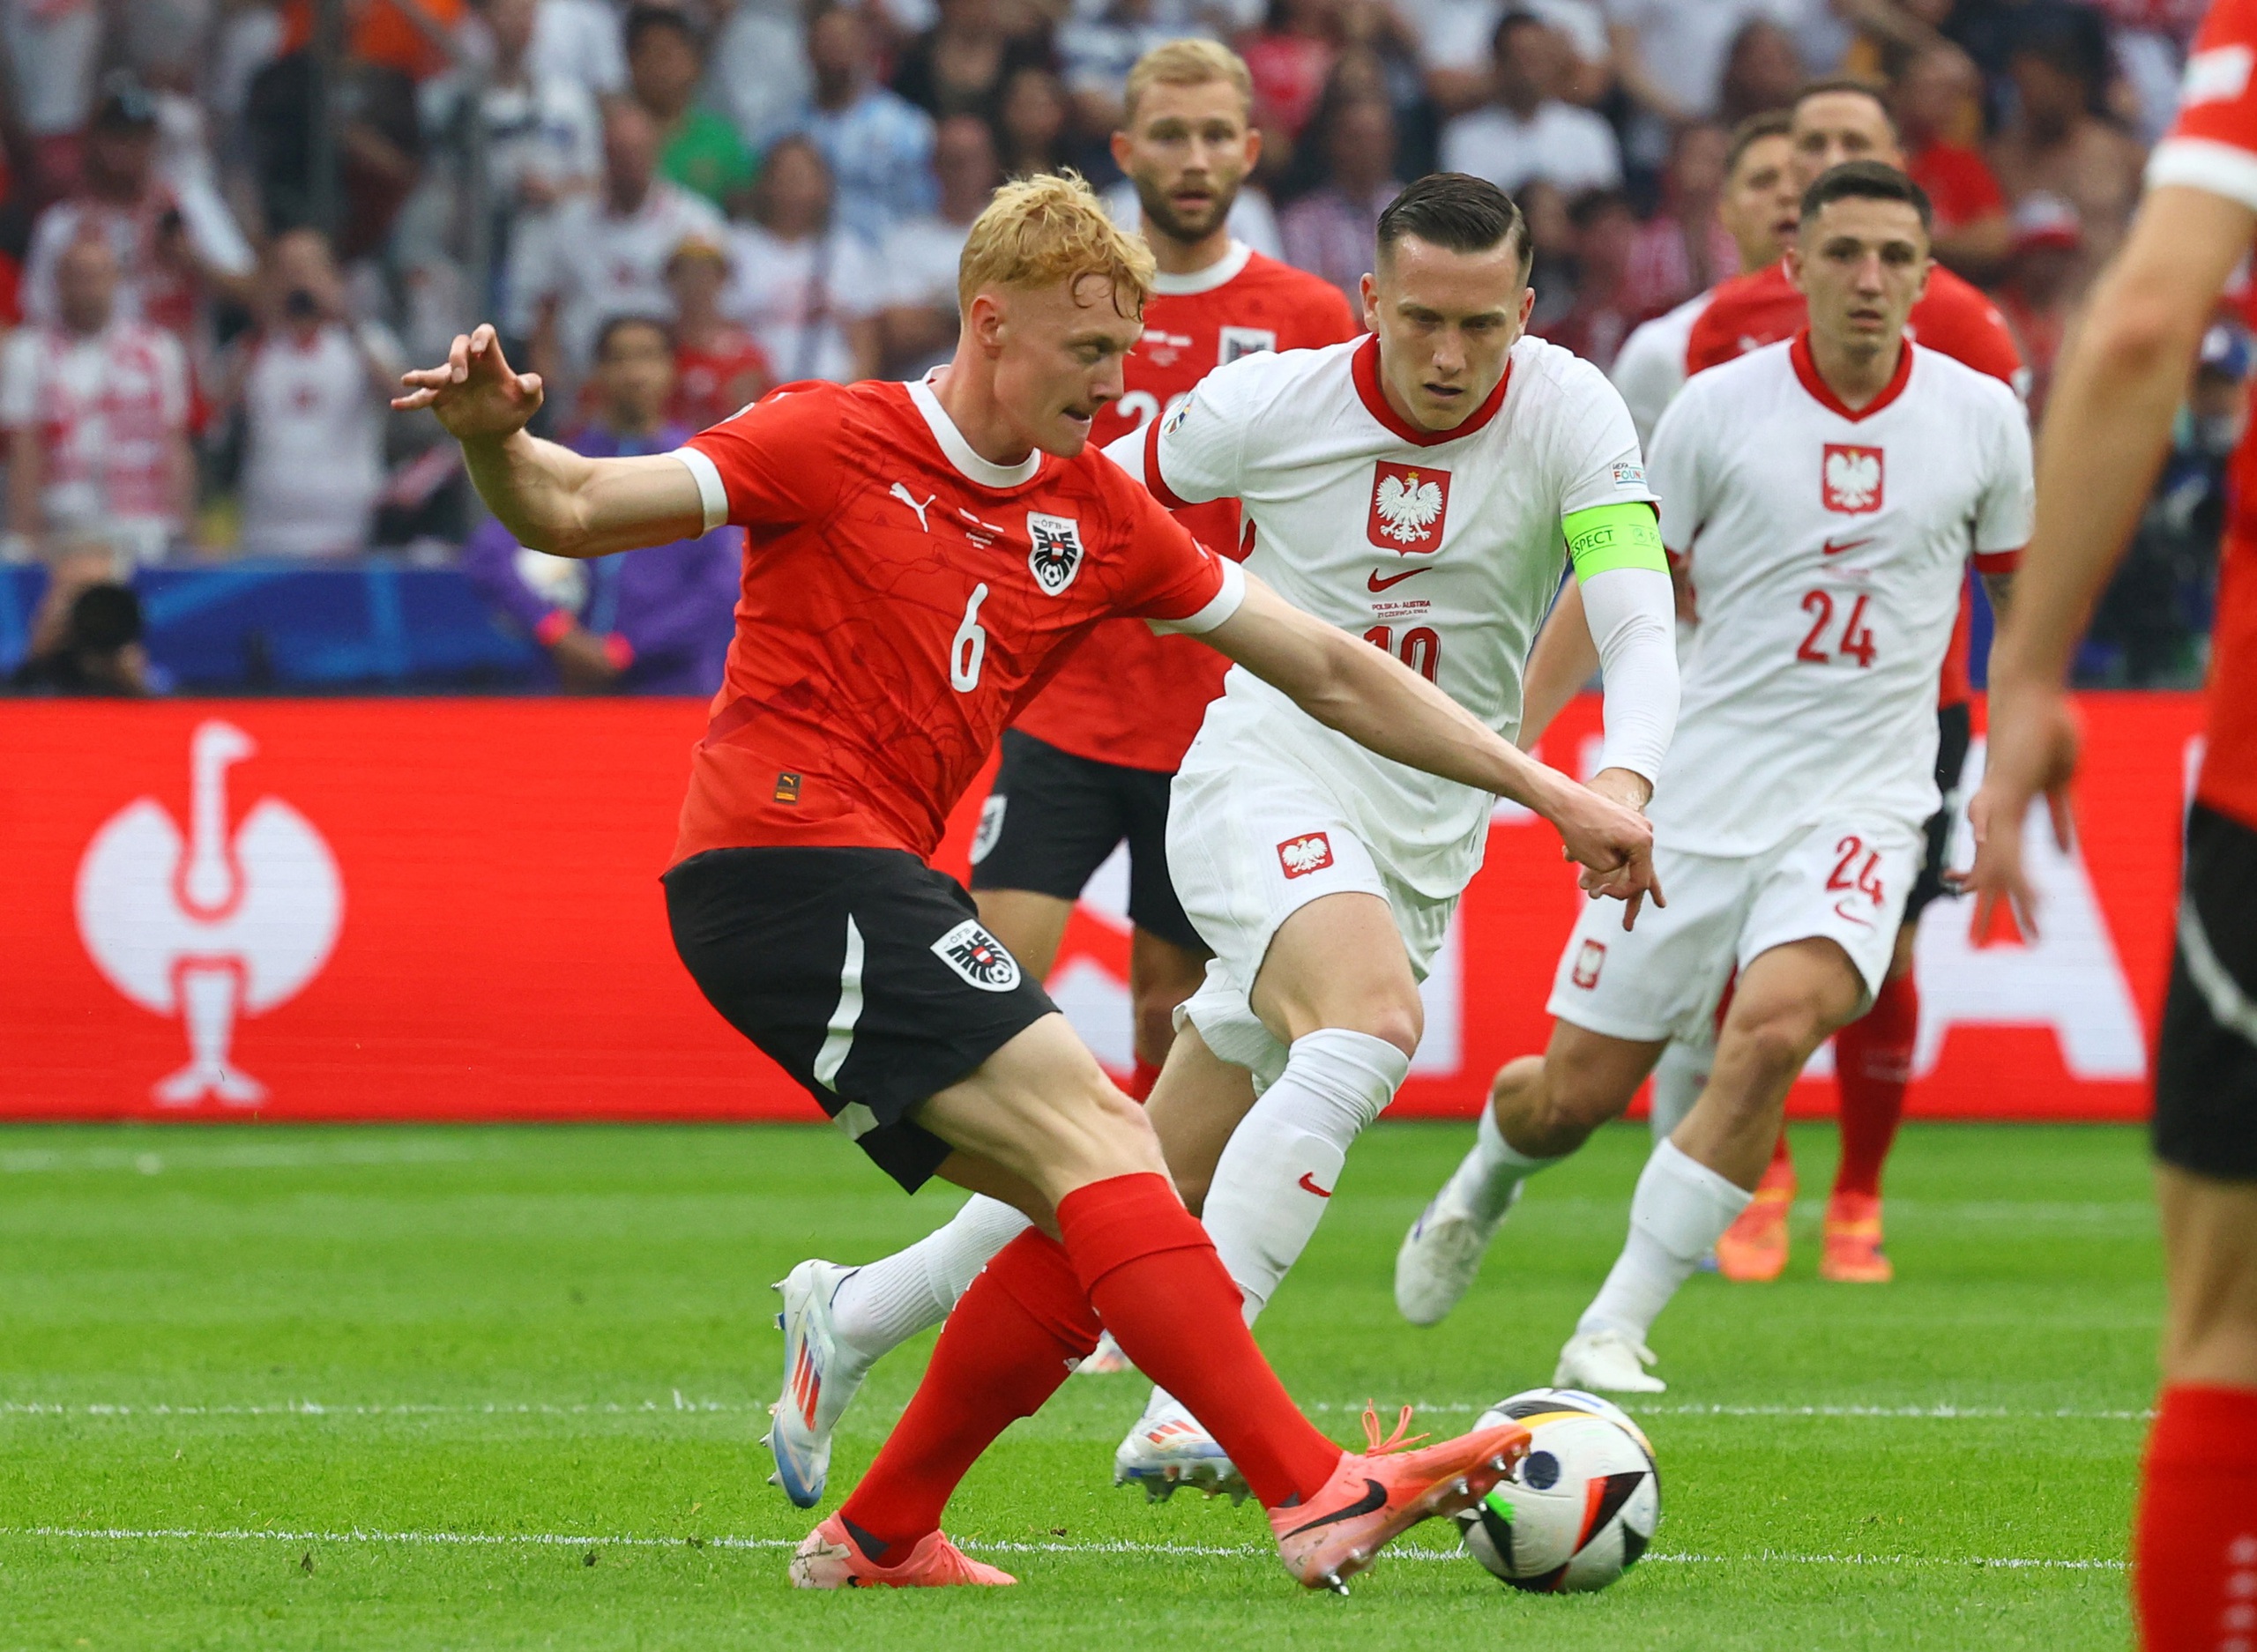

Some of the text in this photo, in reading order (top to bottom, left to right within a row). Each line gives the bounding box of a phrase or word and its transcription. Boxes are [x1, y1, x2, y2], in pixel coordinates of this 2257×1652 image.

[1613, 470, 1643, 480] FOUN
[1571, 530, 1613, 559] ESPECT
[1403, 599, 1431, 608] AUSTRIA
[1797, 589, 1876, 667] 24
[950, 583, 988, 693] 6
[1825, 835, 1884, 905] 24
